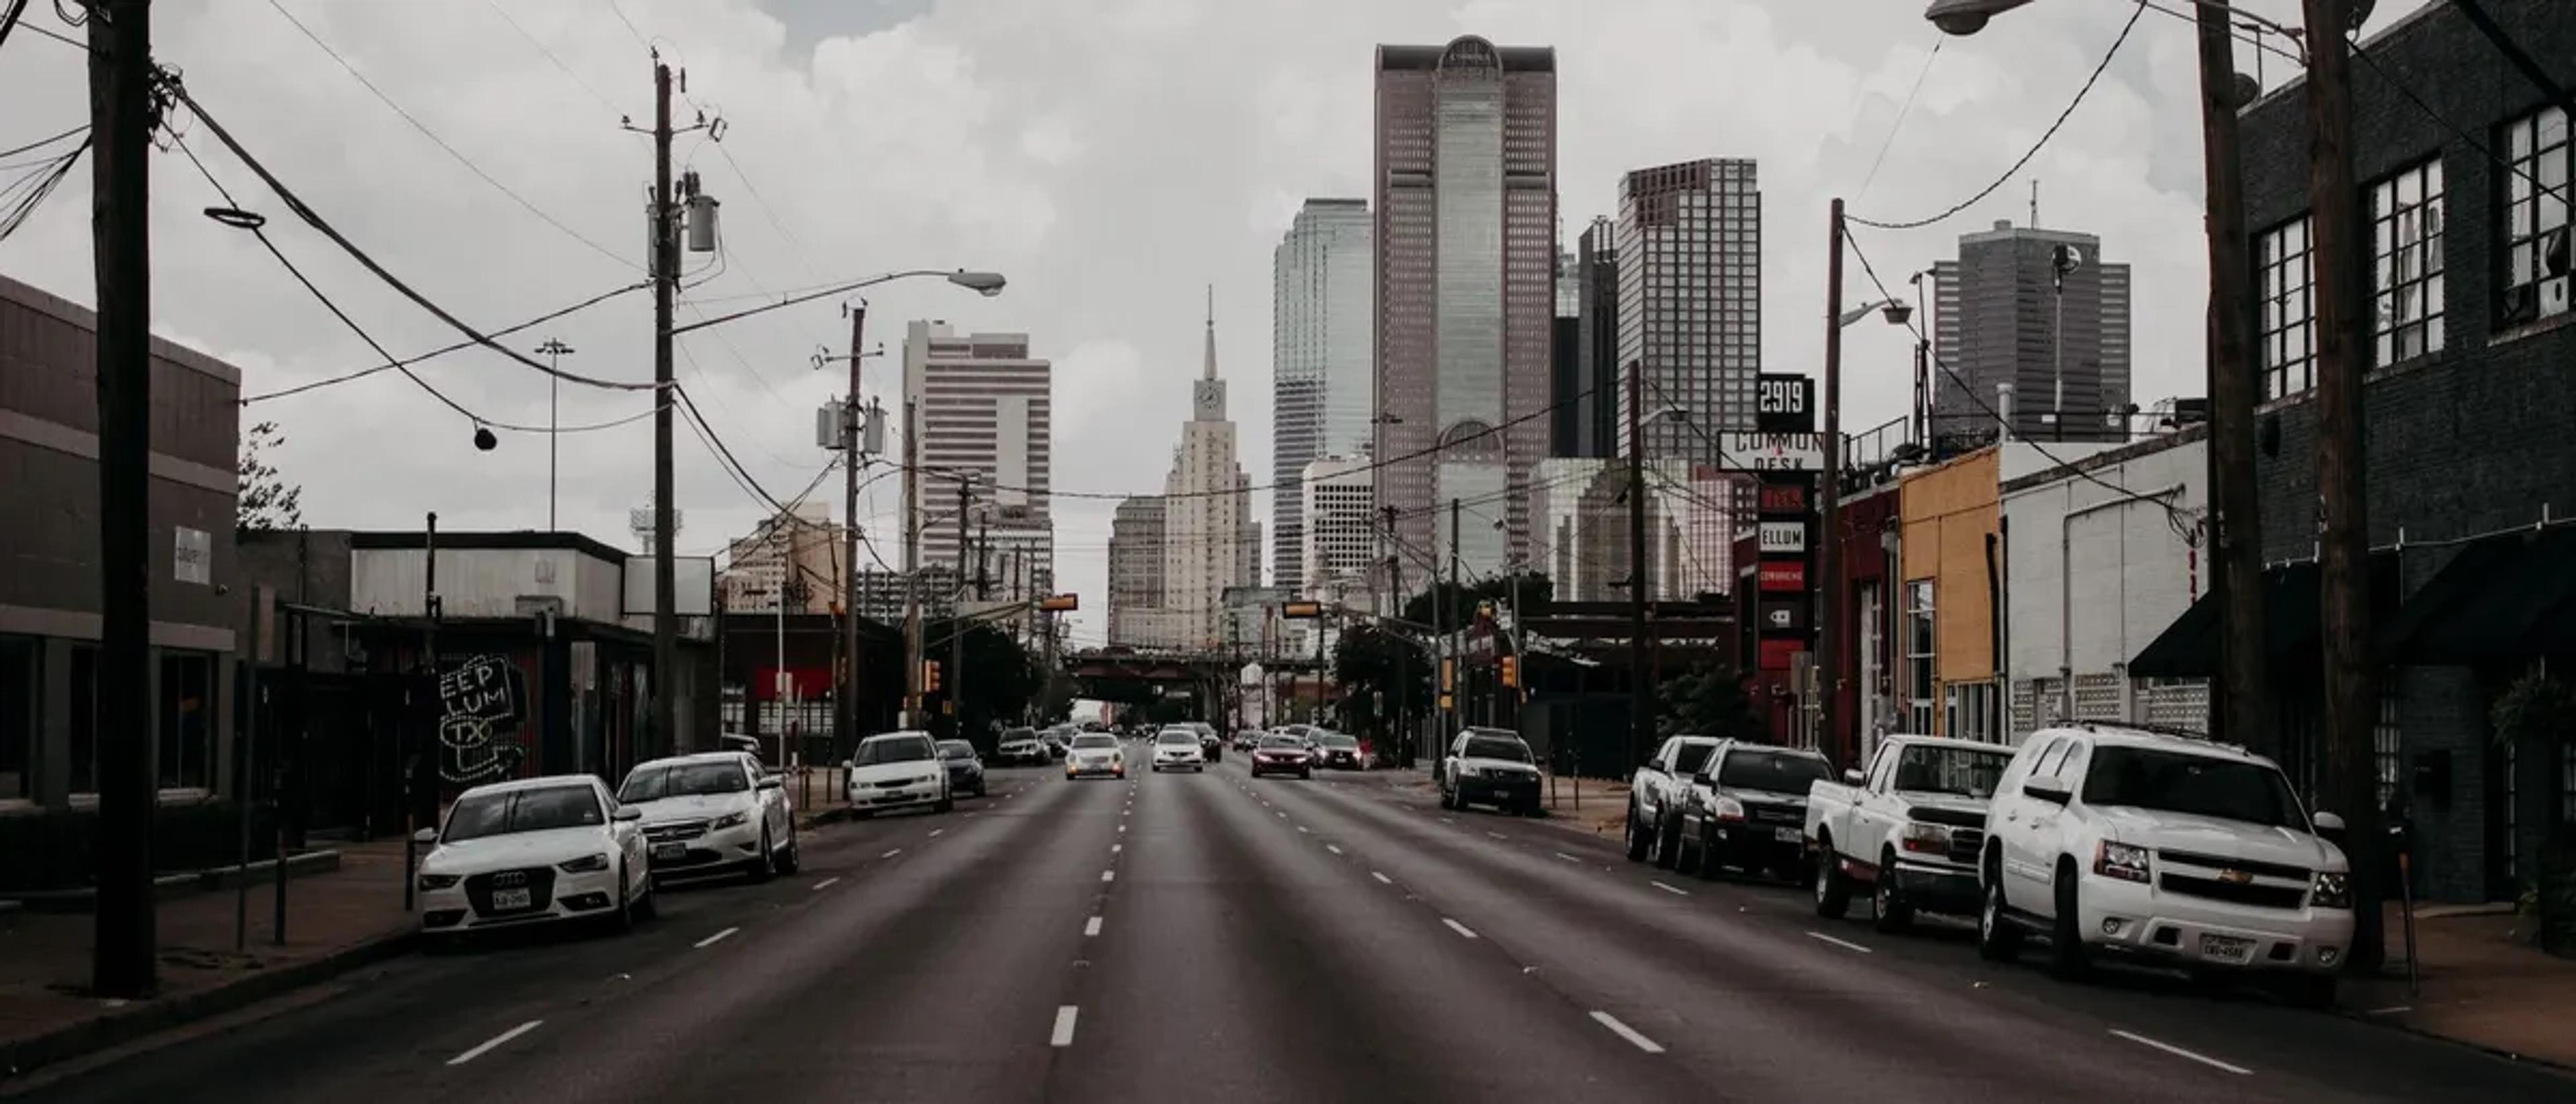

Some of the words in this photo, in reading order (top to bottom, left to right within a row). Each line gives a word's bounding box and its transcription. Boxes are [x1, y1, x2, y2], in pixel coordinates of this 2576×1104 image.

[1760, 381, 1803, 412] 2919
[1735, 432, 1824, 452] COMMON
[1754, 457, 1803, 469] DESK
[1763, 530, 1802, 544] ELLUM
[447, 720, 489, 742] TX
